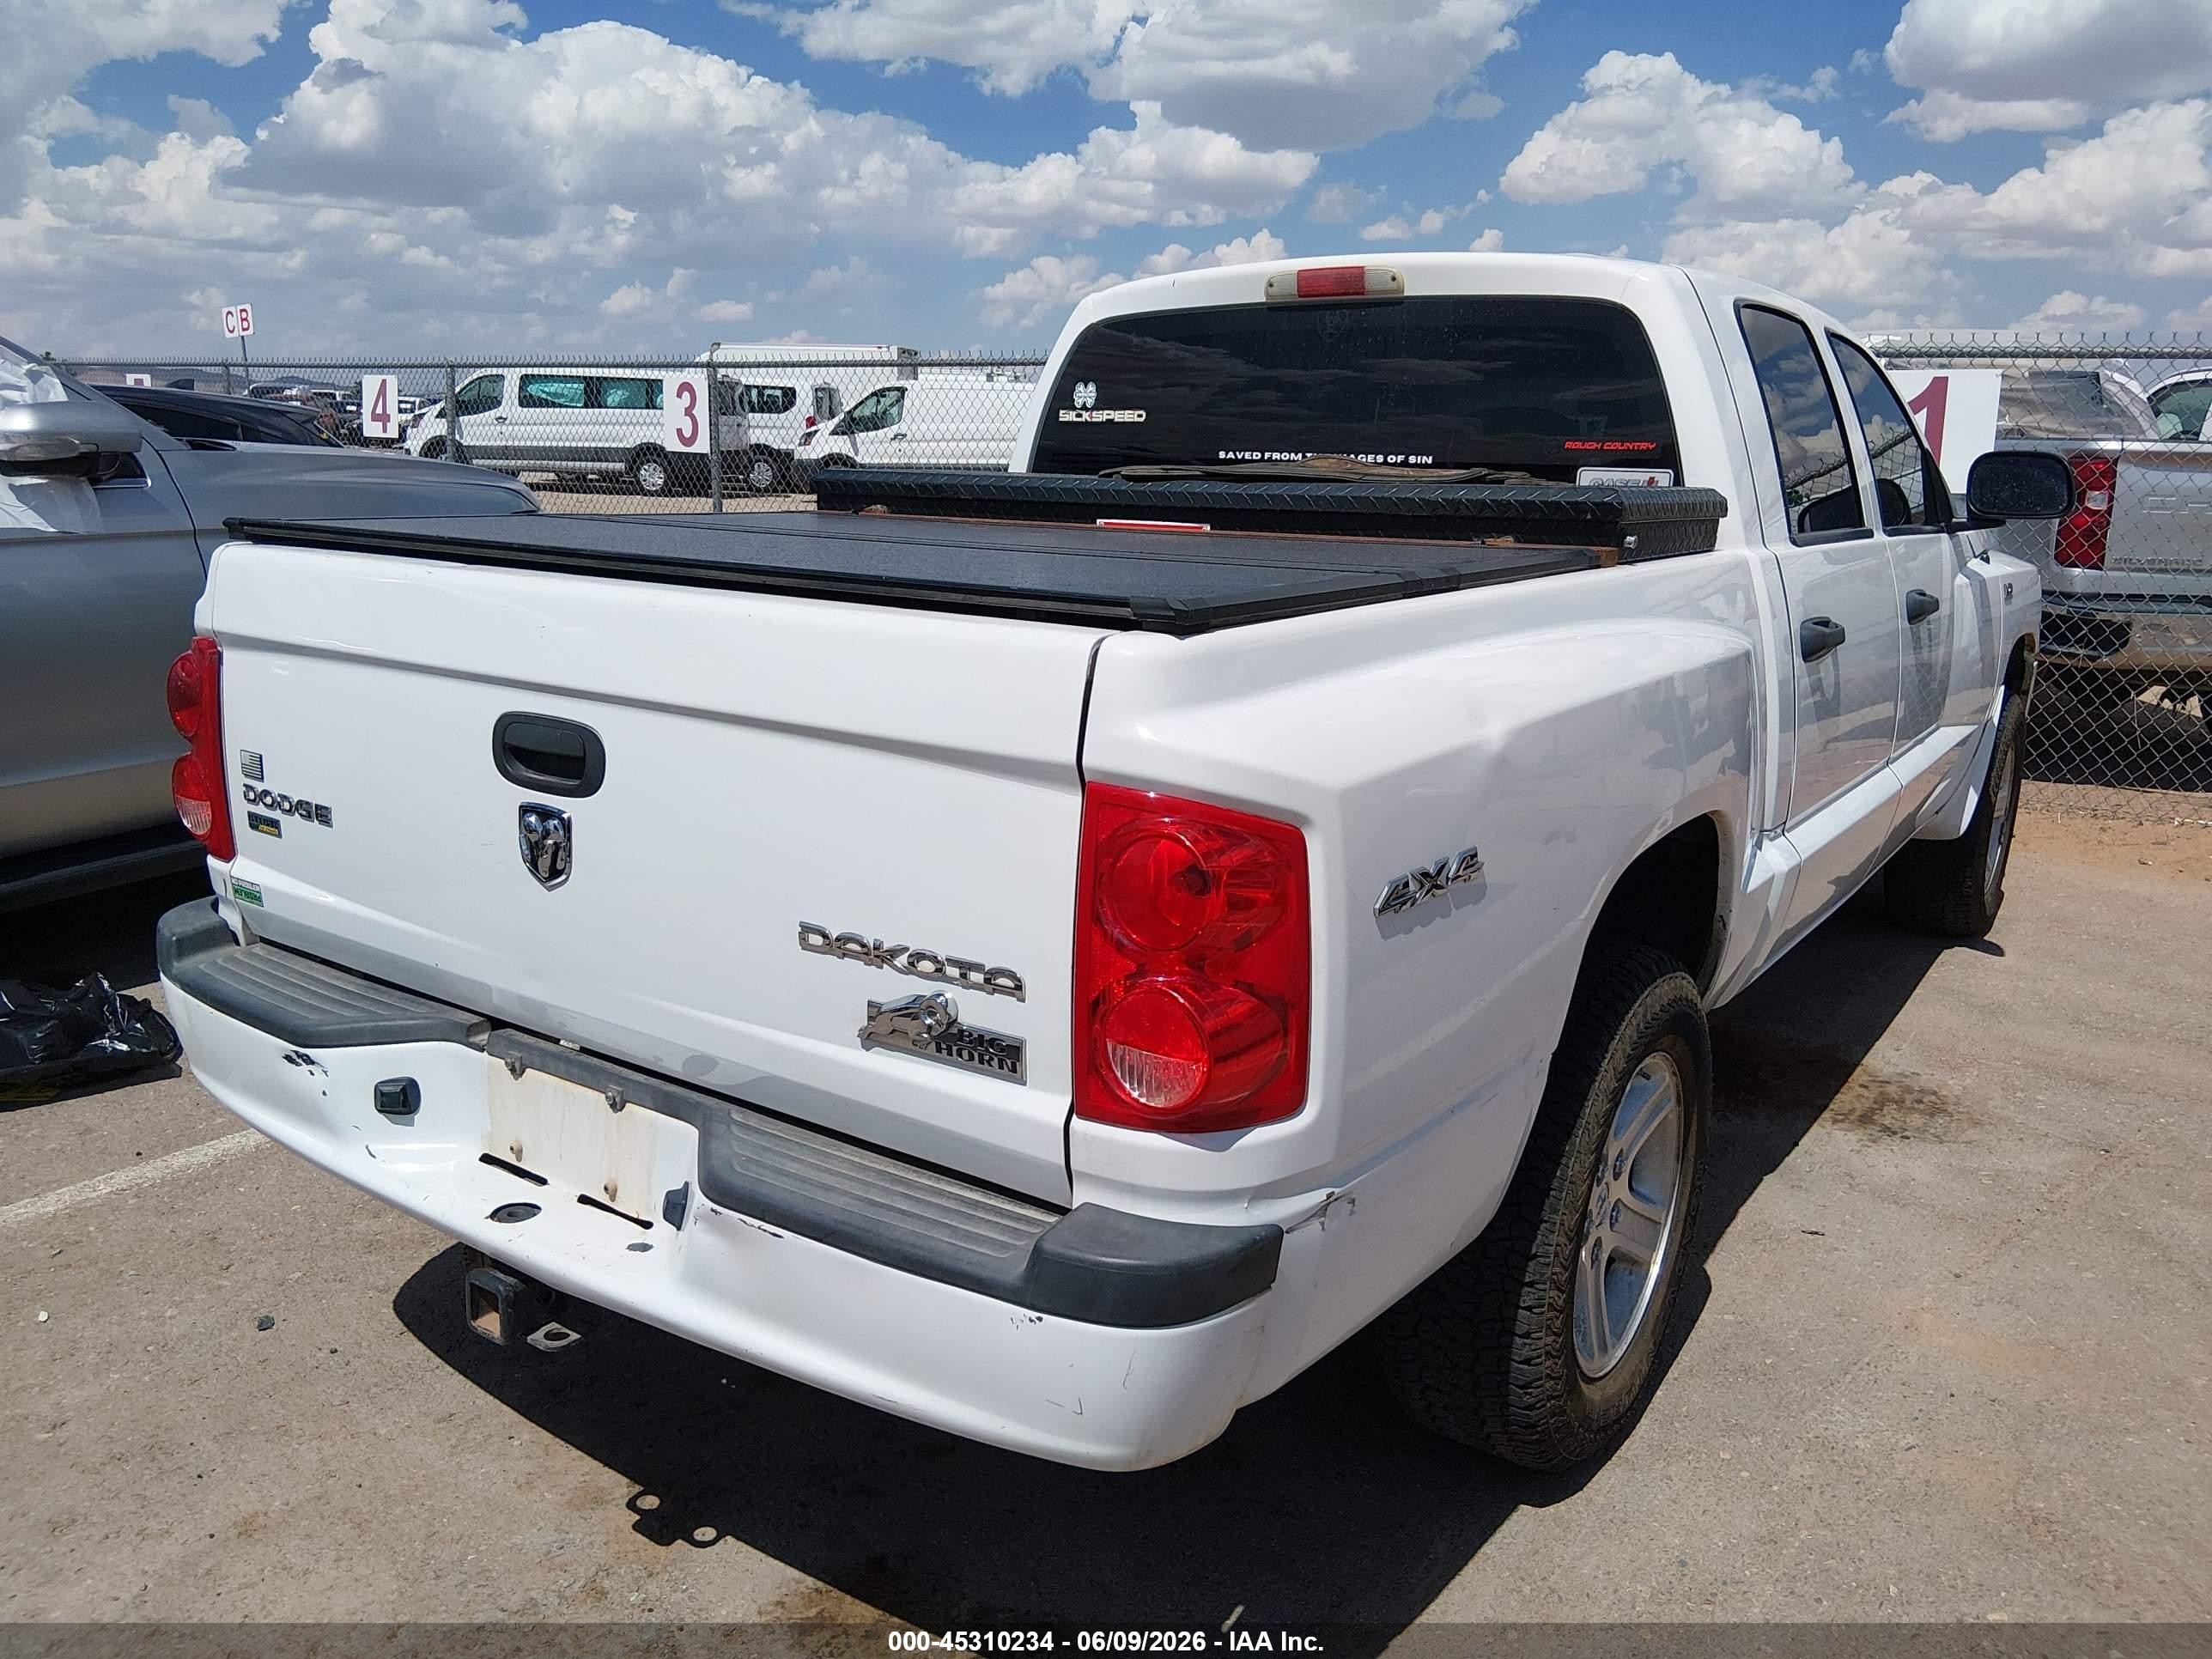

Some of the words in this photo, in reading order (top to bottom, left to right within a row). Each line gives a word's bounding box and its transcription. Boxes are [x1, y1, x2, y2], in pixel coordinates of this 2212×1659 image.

[371, 378, 391, 434] 4
[676, 381, 699, 447] 3
[1058, 410, 1146, 422] SICKSPEED
[1907, 376, 1948, 468] 1
[1218, 451, 1261, 460] SAVED
[1264, 452, 1302, 461] FROM
[1408, 455, 1433, 465] SIN
[243, 783, 333, 829] DODGE
[798, 921, 1026, 1003] DAKOTA
[935, 1041, 1018, 1074] HORN
[957, 1027, 1007, 1055] BIG
